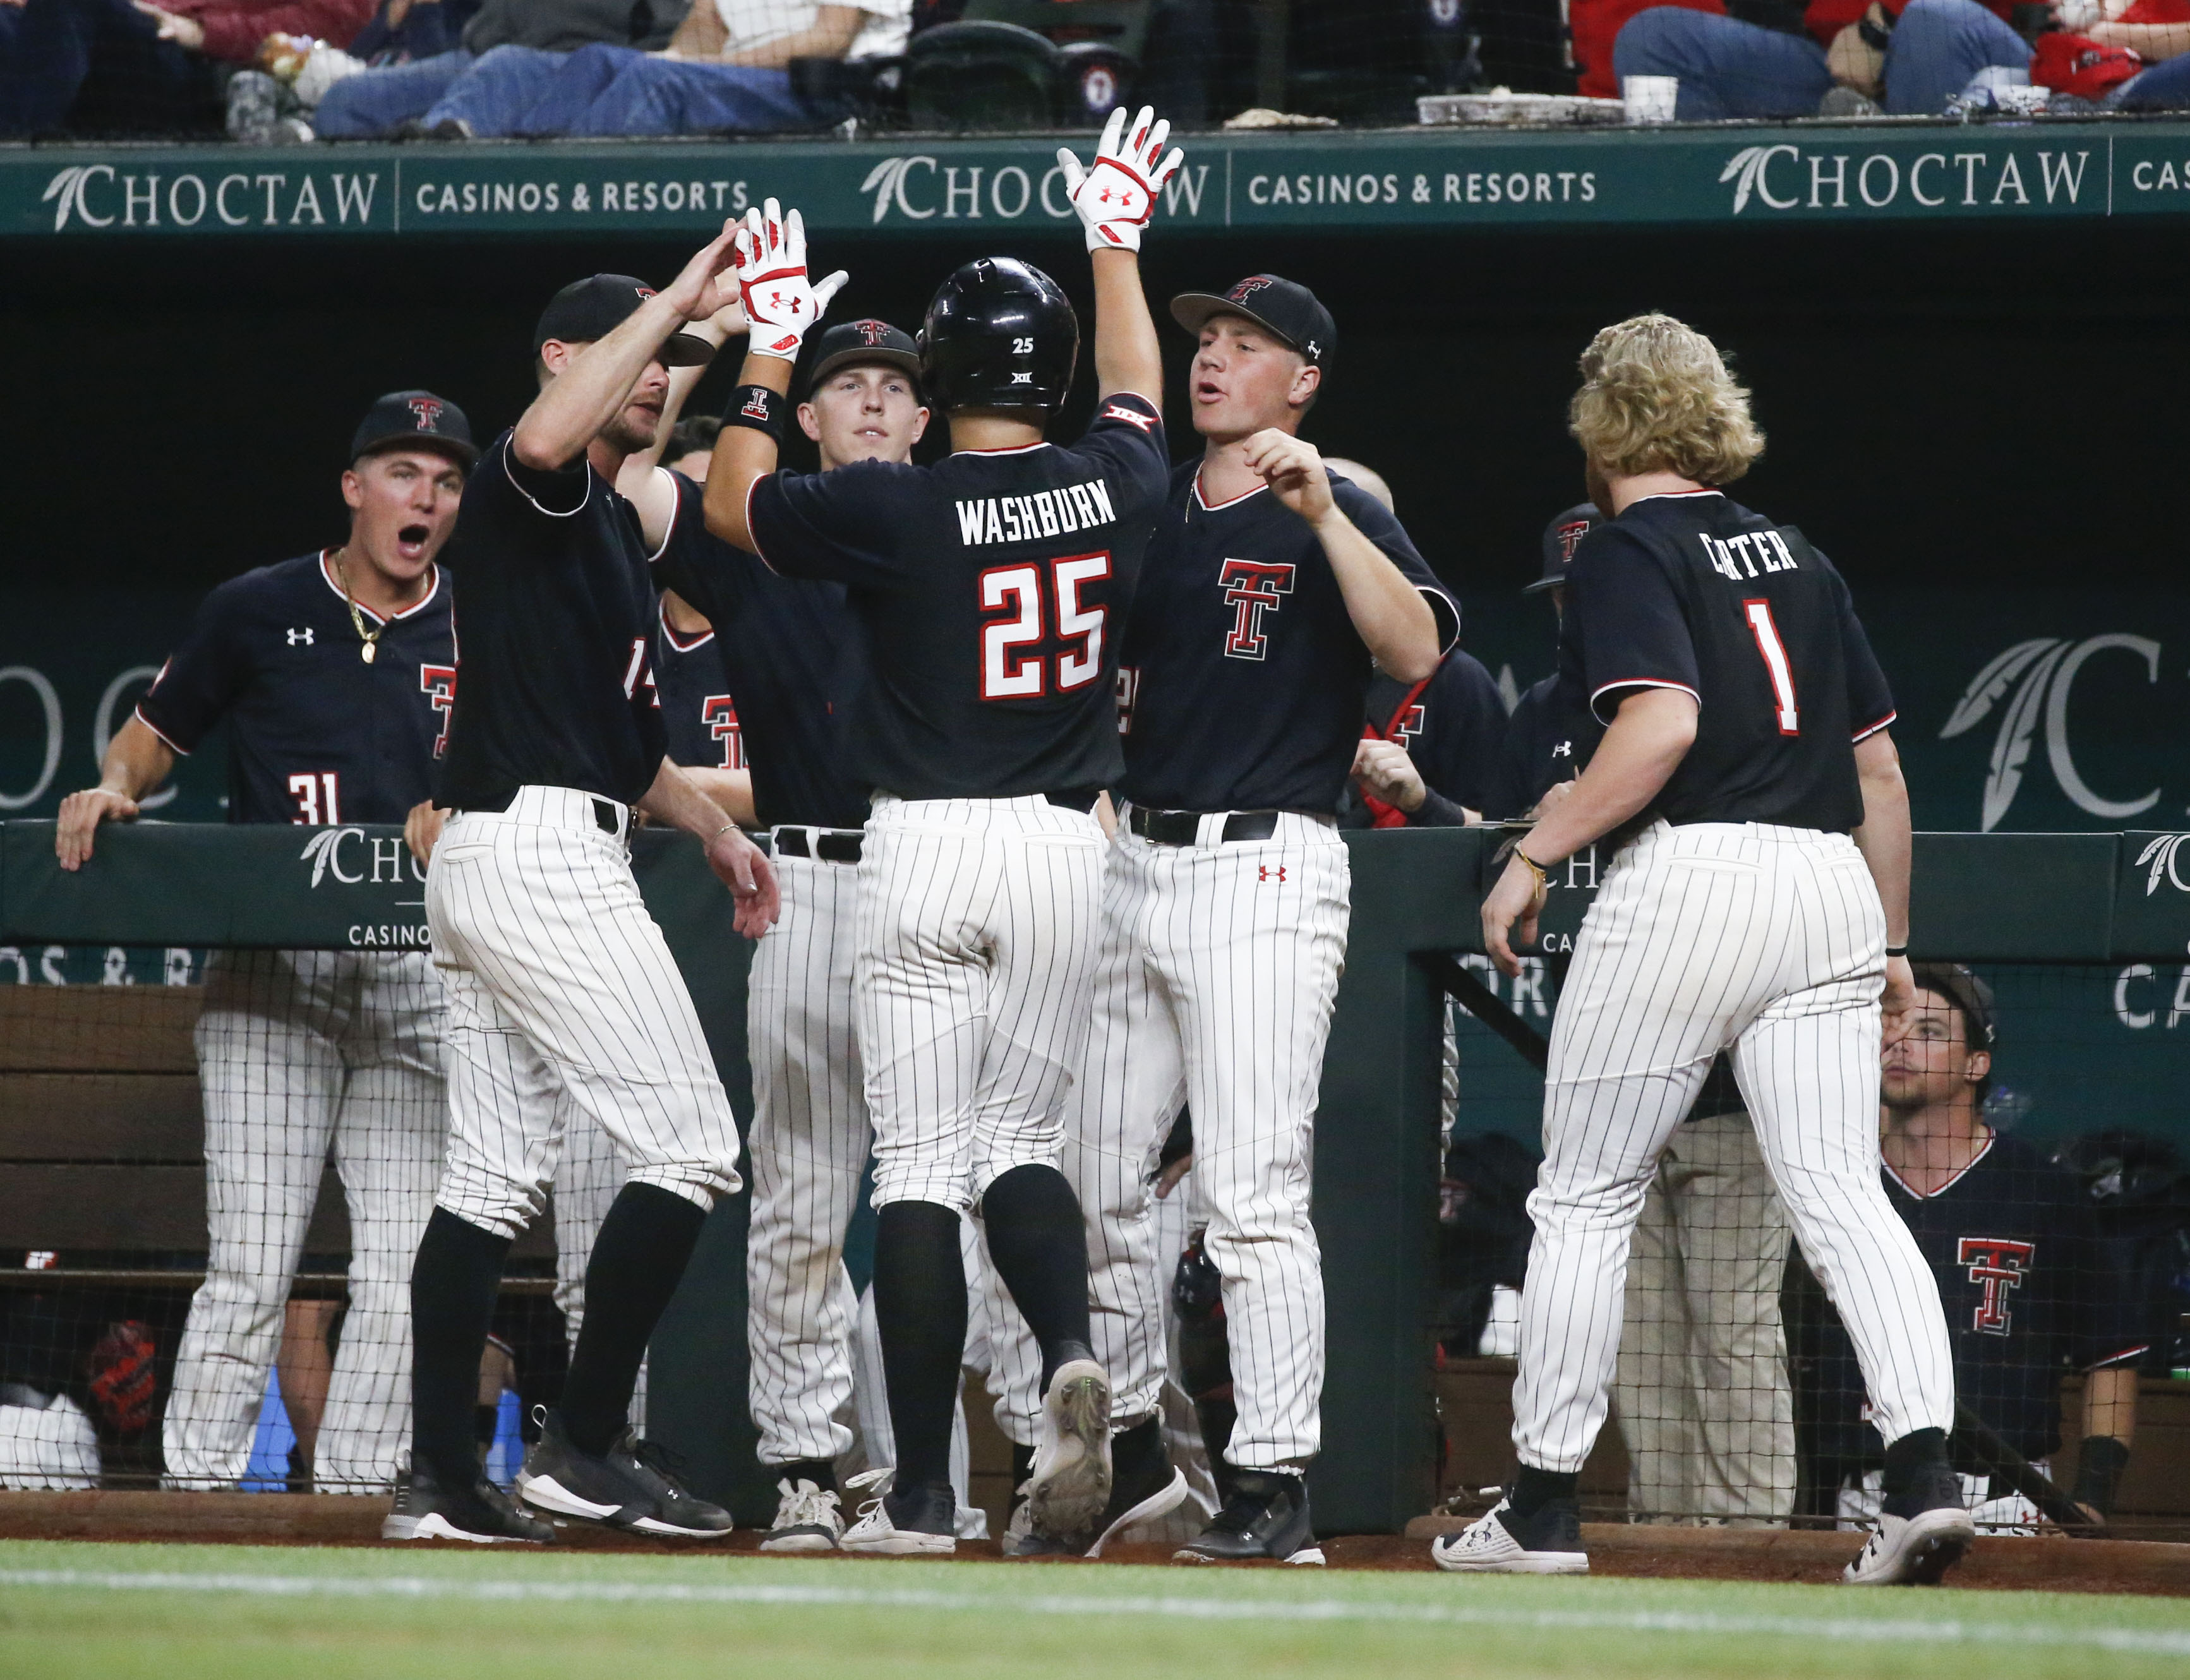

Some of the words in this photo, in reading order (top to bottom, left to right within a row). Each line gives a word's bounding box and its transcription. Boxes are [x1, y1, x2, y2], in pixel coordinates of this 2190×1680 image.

[75, 165, 377, 228] CHOCTAW
[416, 182, 560, 213] CASINOS
[571, 183, 591, 212] &
[602, 181, 749, 211] RESORTS
[895, 155, 1211, 220] CHOCW
[1248, 174, 1398, 205] CASINOS
[1411, 174, 1431, 203] &
[1444, 172, 1596, 203] RESORTS
[1756, 145, 2090, 209] CHOCTAW
[1012, 337, 1034, 354] 25
[1011, 371, 1033, 384] XII
[956, 479, 1117, 546] WASHBURN
[1699, 531, 1799, 580] CRTER
[979, 549, 1113, 702] 25
[1742, 597, 1800, 737] 1
[1116, 665, 1140, 735] 2
[288, 772, 340, 825] 31
